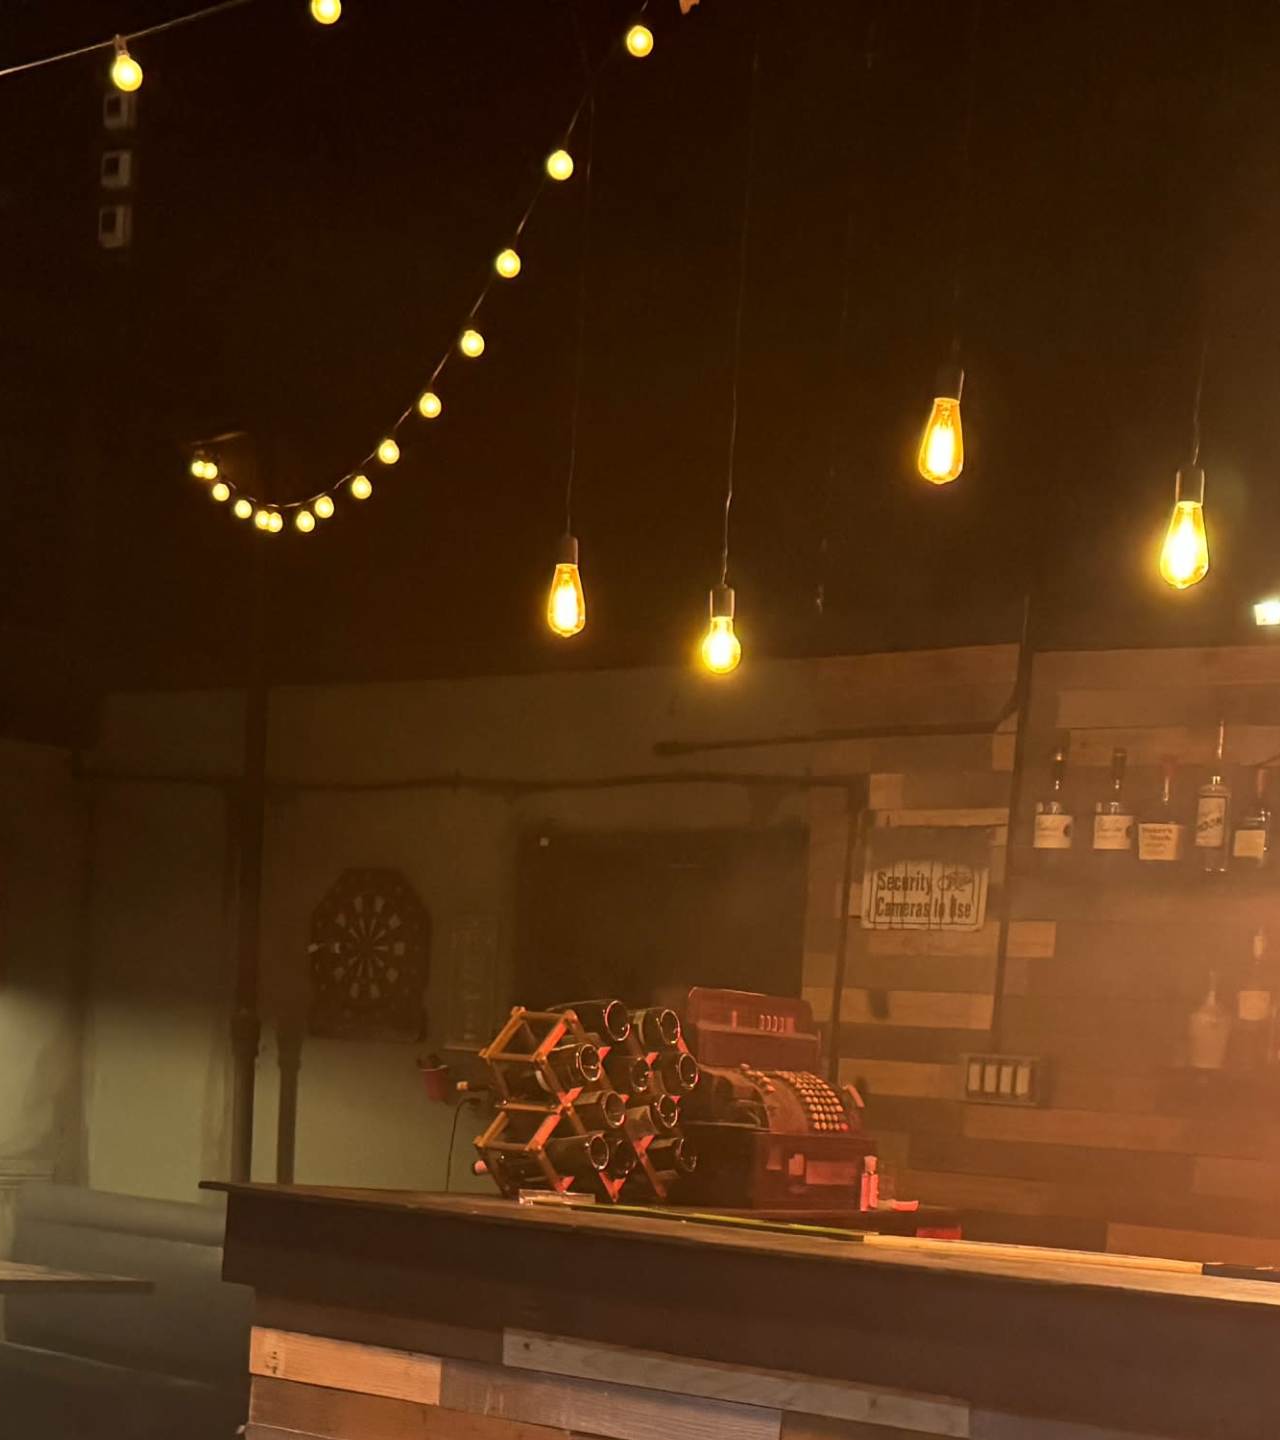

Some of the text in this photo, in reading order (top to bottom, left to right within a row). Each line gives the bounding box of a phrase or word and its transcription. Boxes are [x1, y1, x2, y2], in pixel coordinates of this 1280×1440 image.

[877, 871, 932, 895] Security
[876, 897, 930, 918] Cameras
[950, 896, 972, 919] Use
